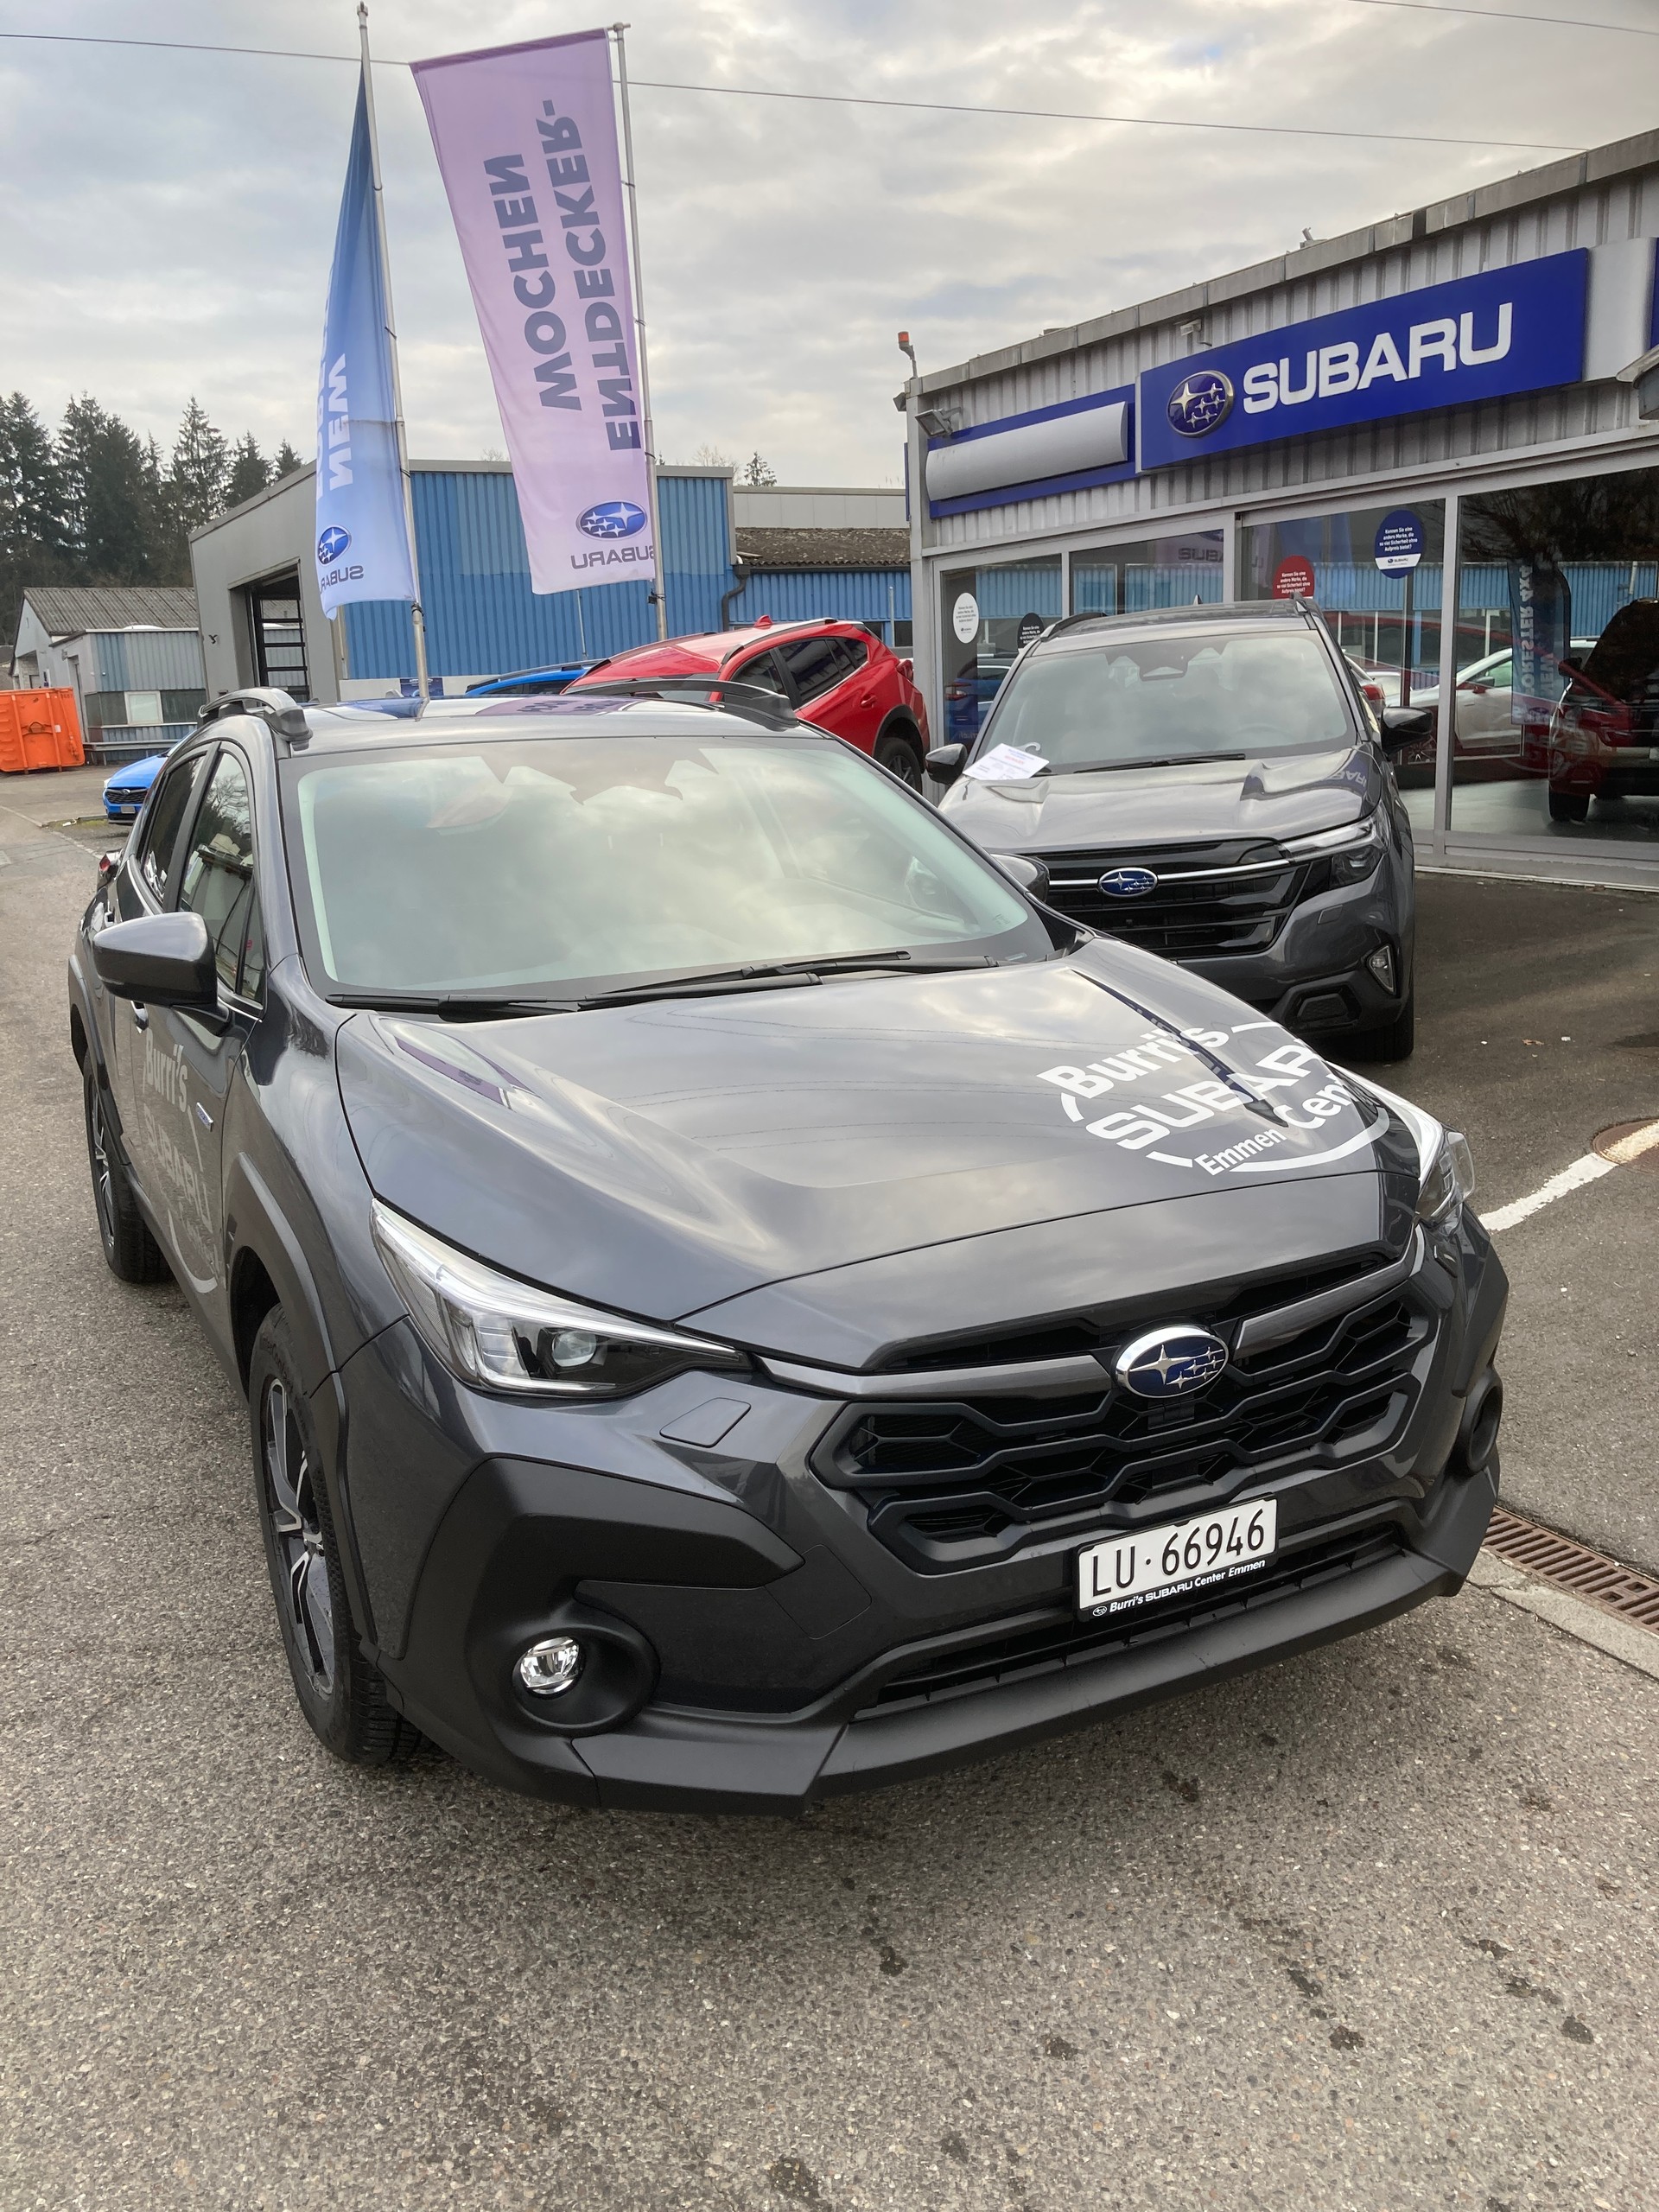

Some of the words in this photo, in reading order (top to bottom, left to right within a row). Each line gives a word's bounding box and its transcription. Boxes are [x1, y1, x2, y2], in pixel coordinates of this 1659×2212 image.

[1243, 302, 1512, 414] SUBARU
[1086, 1038, 1324, 1150] SUBAR
[1194, 1128, 1287, 1176] Emmen
[1109, 1596, 1144, 1613] Burri's
[1145, 1581, 1193, 1602] SUBARU
[1194, 1571, 1225, 1586] Center
[1228, 1560, 1265, 1577] Emmen
